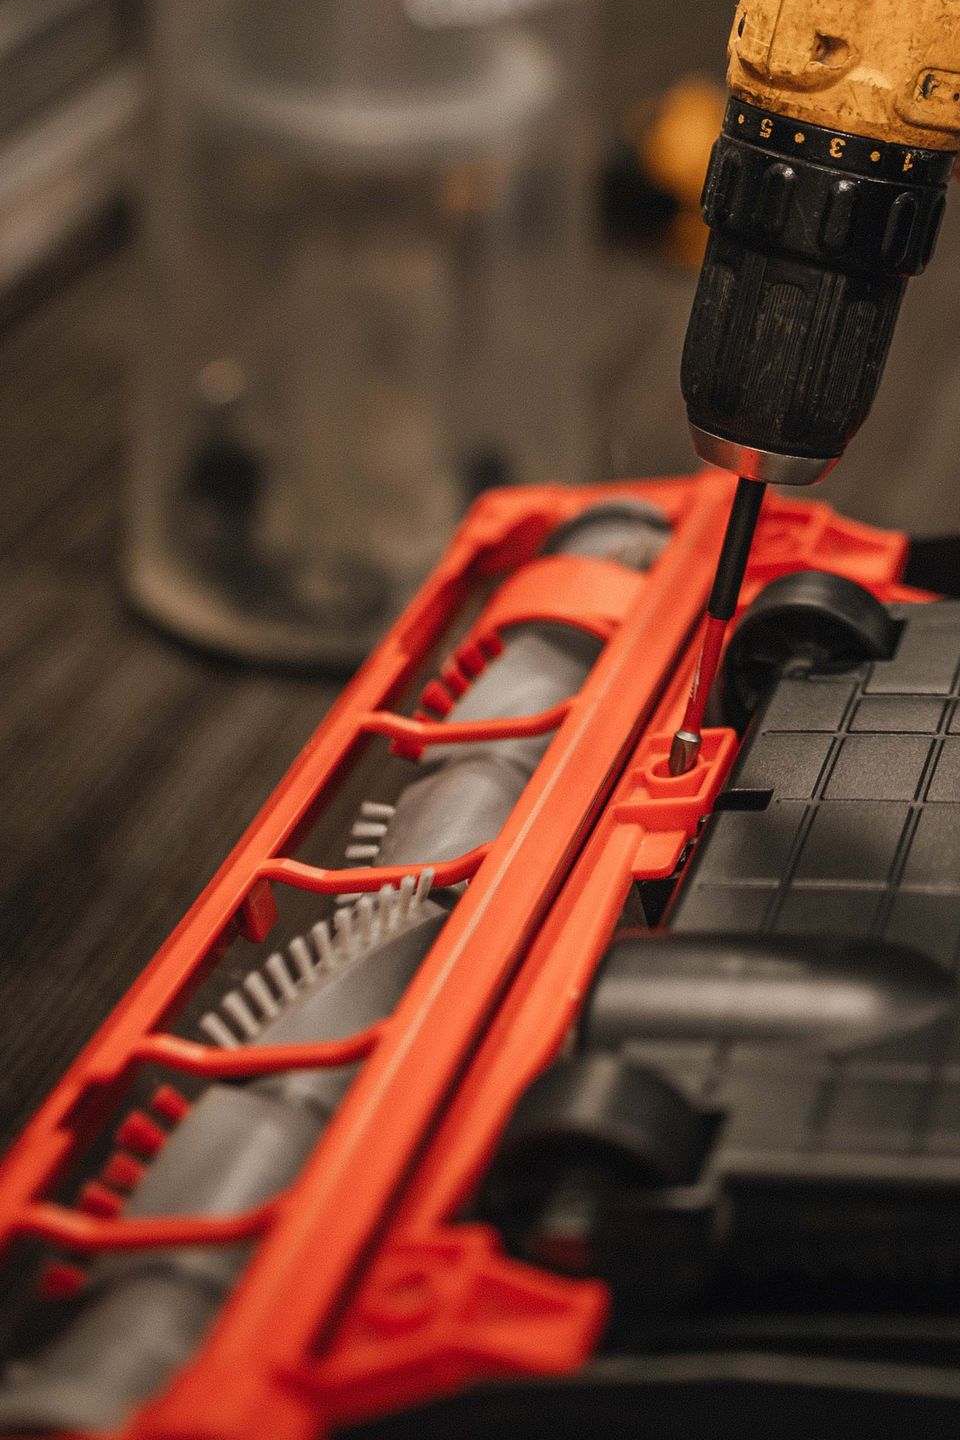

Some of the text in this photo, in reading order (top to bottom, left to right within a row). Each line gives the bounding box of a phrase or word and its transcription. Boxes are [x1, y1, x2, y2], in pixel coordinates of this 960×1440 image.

[759, 118, 913, 172] 1 3 5
